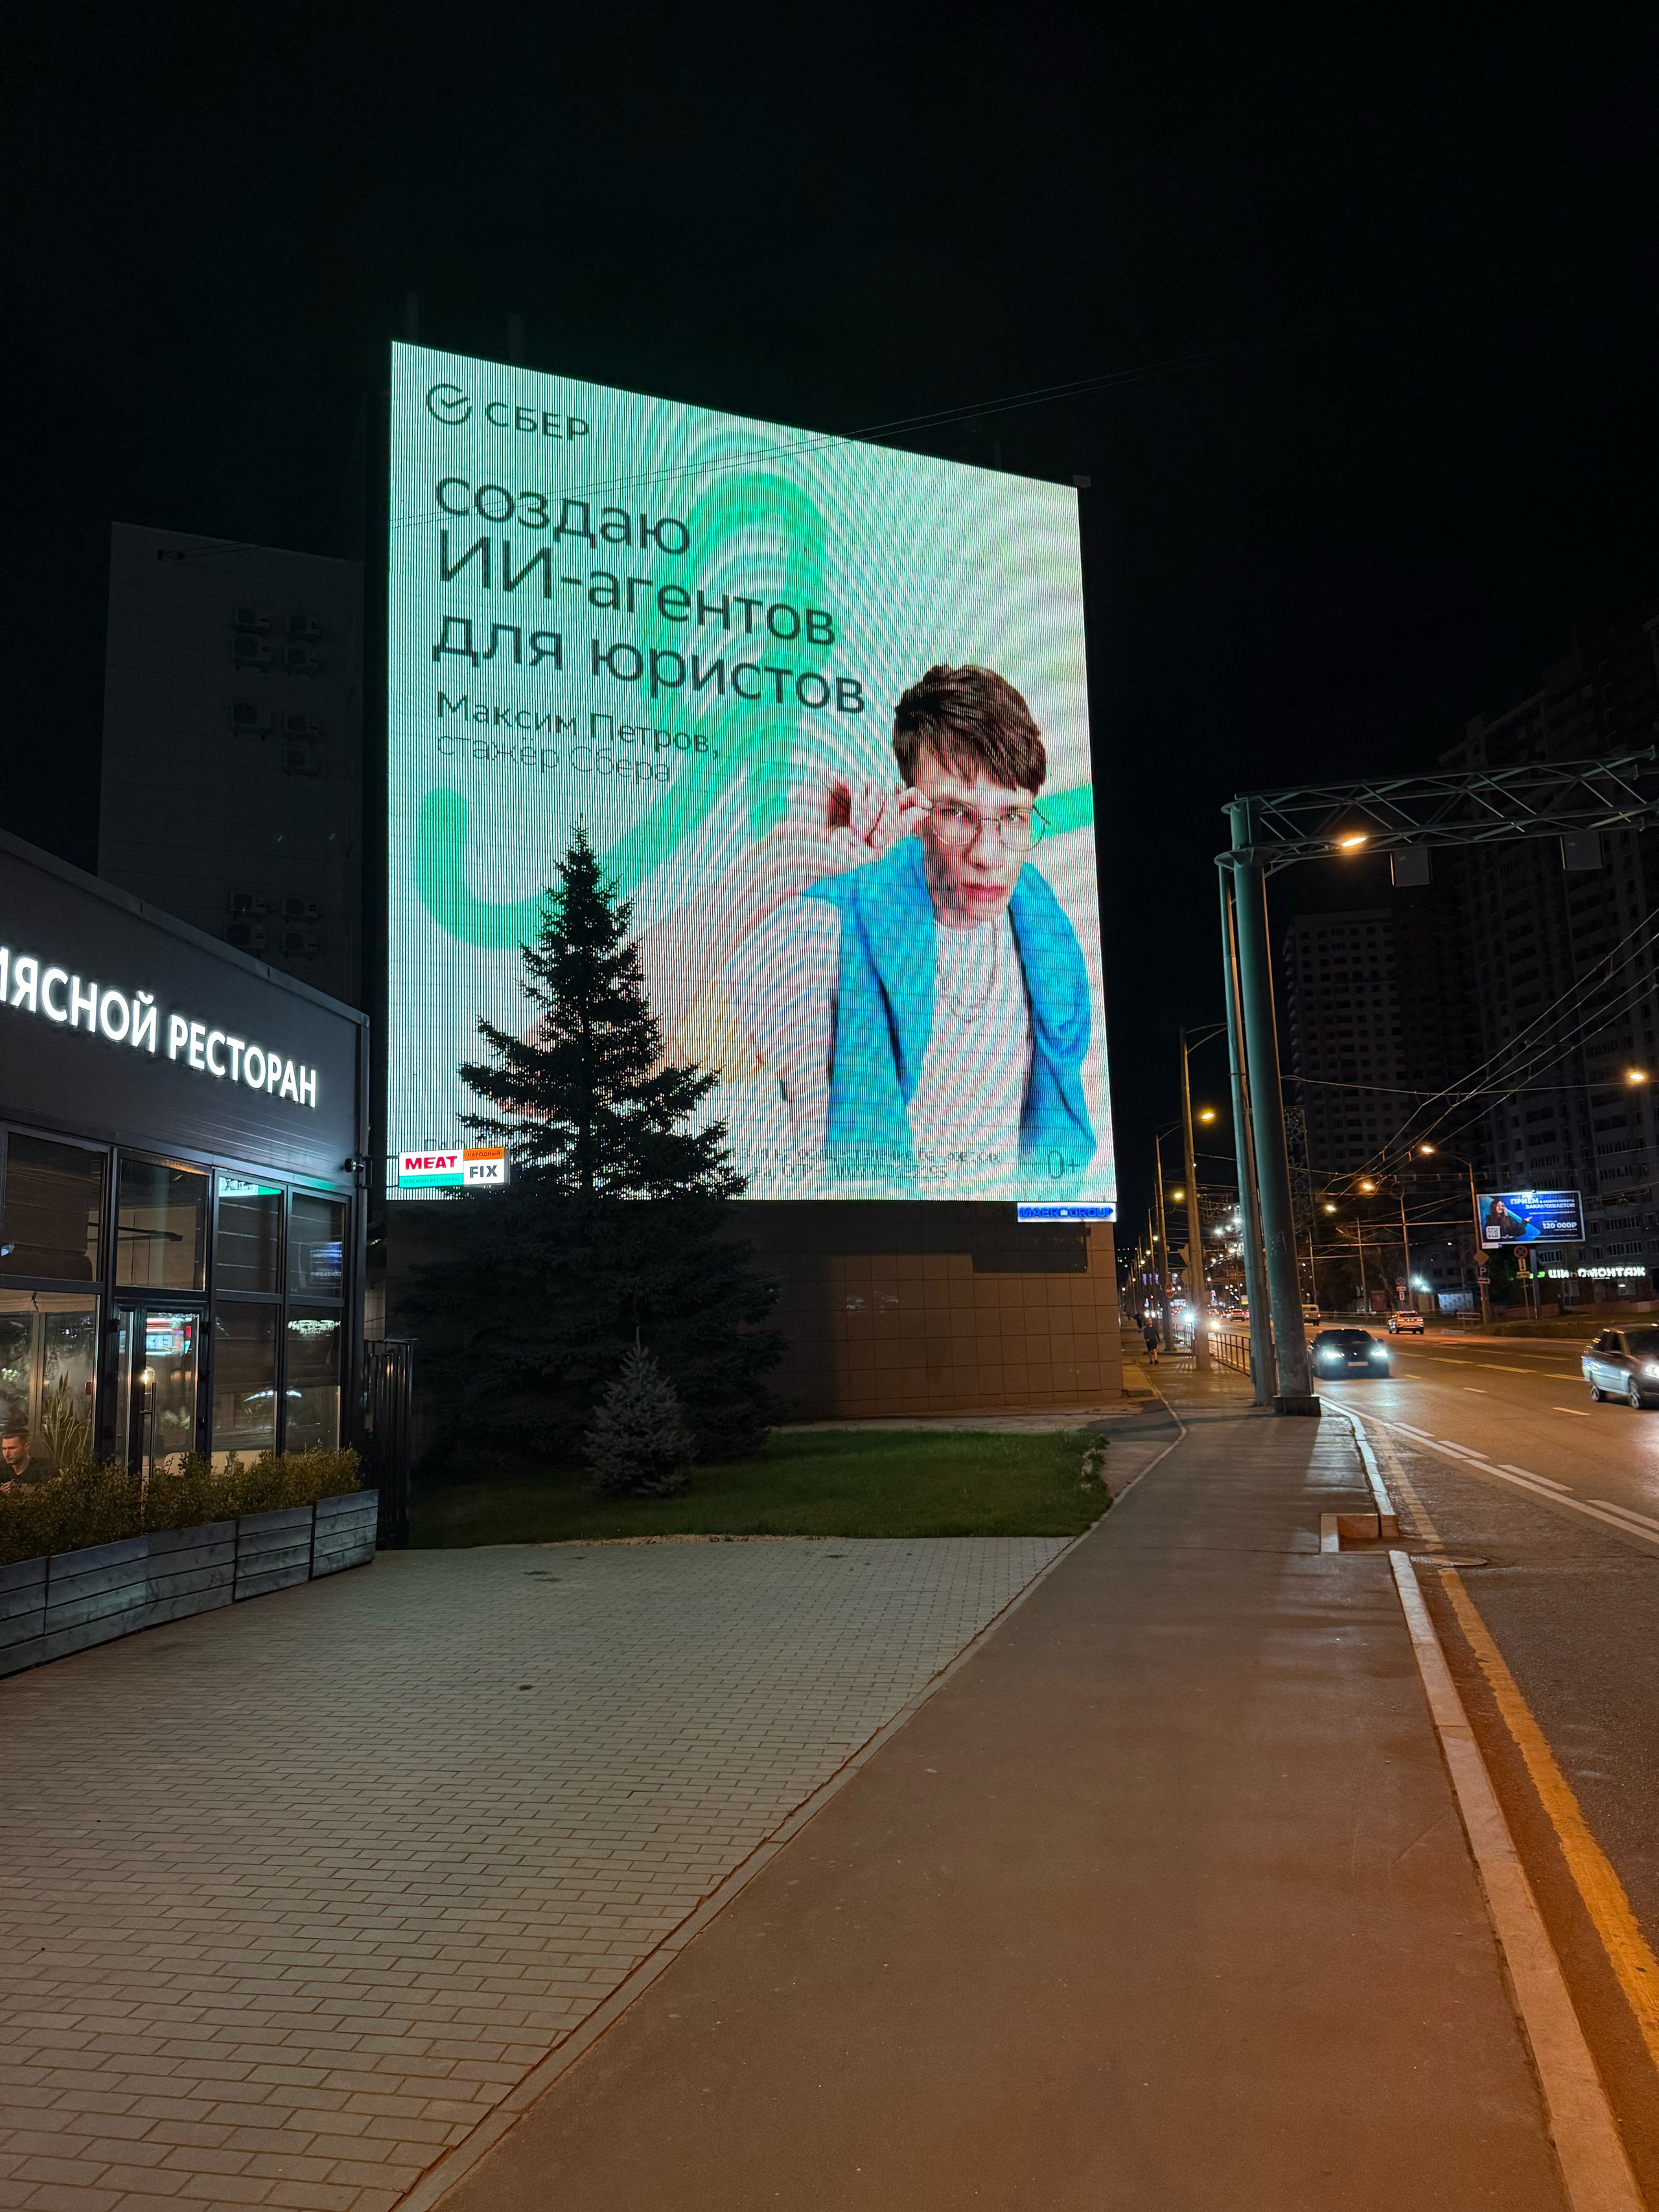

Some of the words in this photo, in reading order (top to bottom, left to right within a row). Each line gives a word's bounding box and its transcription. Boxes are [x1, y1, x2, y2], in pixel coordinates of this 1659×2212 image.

[486, 402, 589, 441] СБЕР
[436, 477, 690, 555] создаю
[440, 530, 837, 646] ИИ-агентов
[432, 614, 563, 670] для
[592, 638, 866, 714] юристов
[437, 691, 577, 735] Максим
[591, 712, 719, 760] Петров,
[571, 745, 670, 785] Сбера
[0, 947, 157, 1053] ЯСНОЙ
[169, 1014, 317, 1108] РЕСТОРАН
[406, 1156, 458, 1170] MEAT
[470, 1165, 498, 1178] FIX
[1047, 1150, 1080, 1180] 0+
